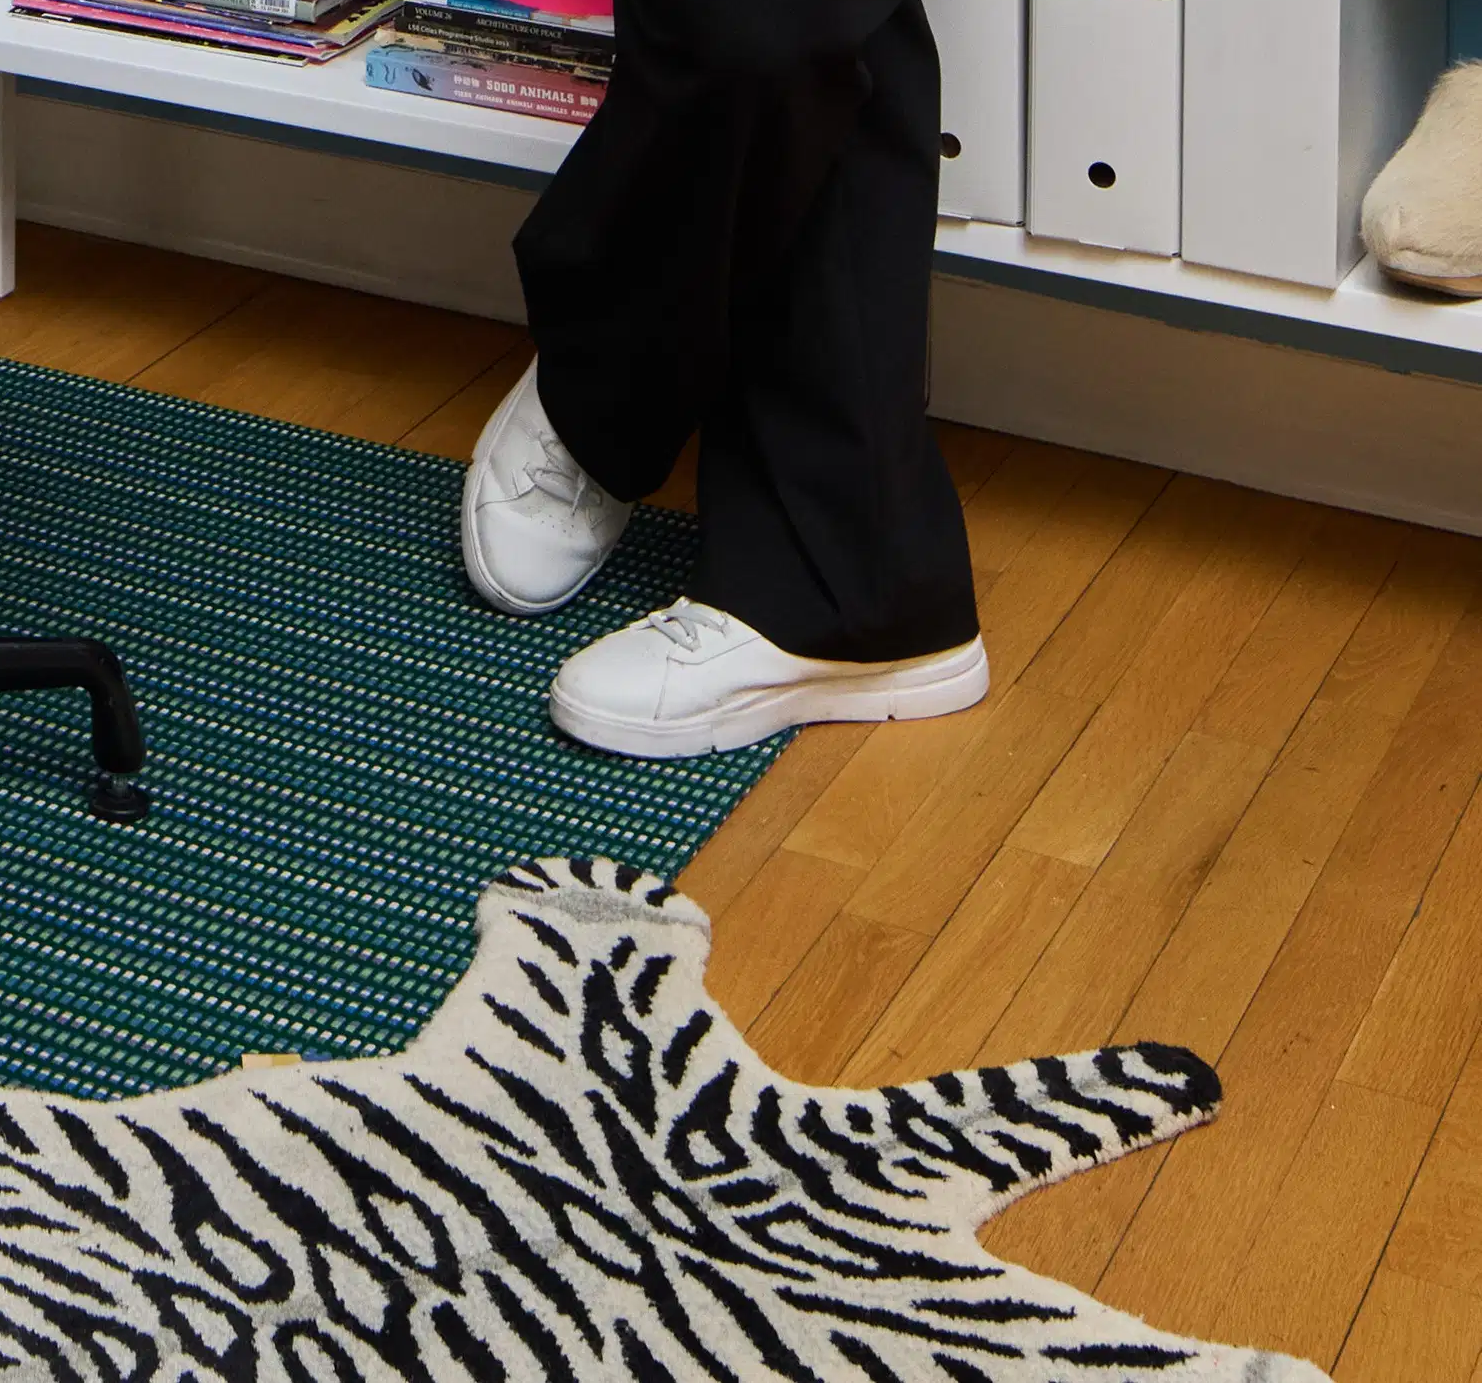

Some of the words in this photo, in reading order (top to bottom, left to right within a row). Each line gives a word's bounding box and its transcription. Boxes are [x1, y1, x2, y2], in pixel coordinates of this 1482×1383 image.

[415, 7, 443, 17] VOLUME
[420, 25, 437, 34] Cities
[475, 36, 494, 44] Studio
[475, 18, 530, 32] ARCHITECTURE
[531, 26, 539, 34] OF
[541, 27, 562, 38] PEACE
[486, 80, 515, 94] 5000
[520, 86, 574, 104] ANIMALS
[536, 104, 568, 115] ANIMALES
